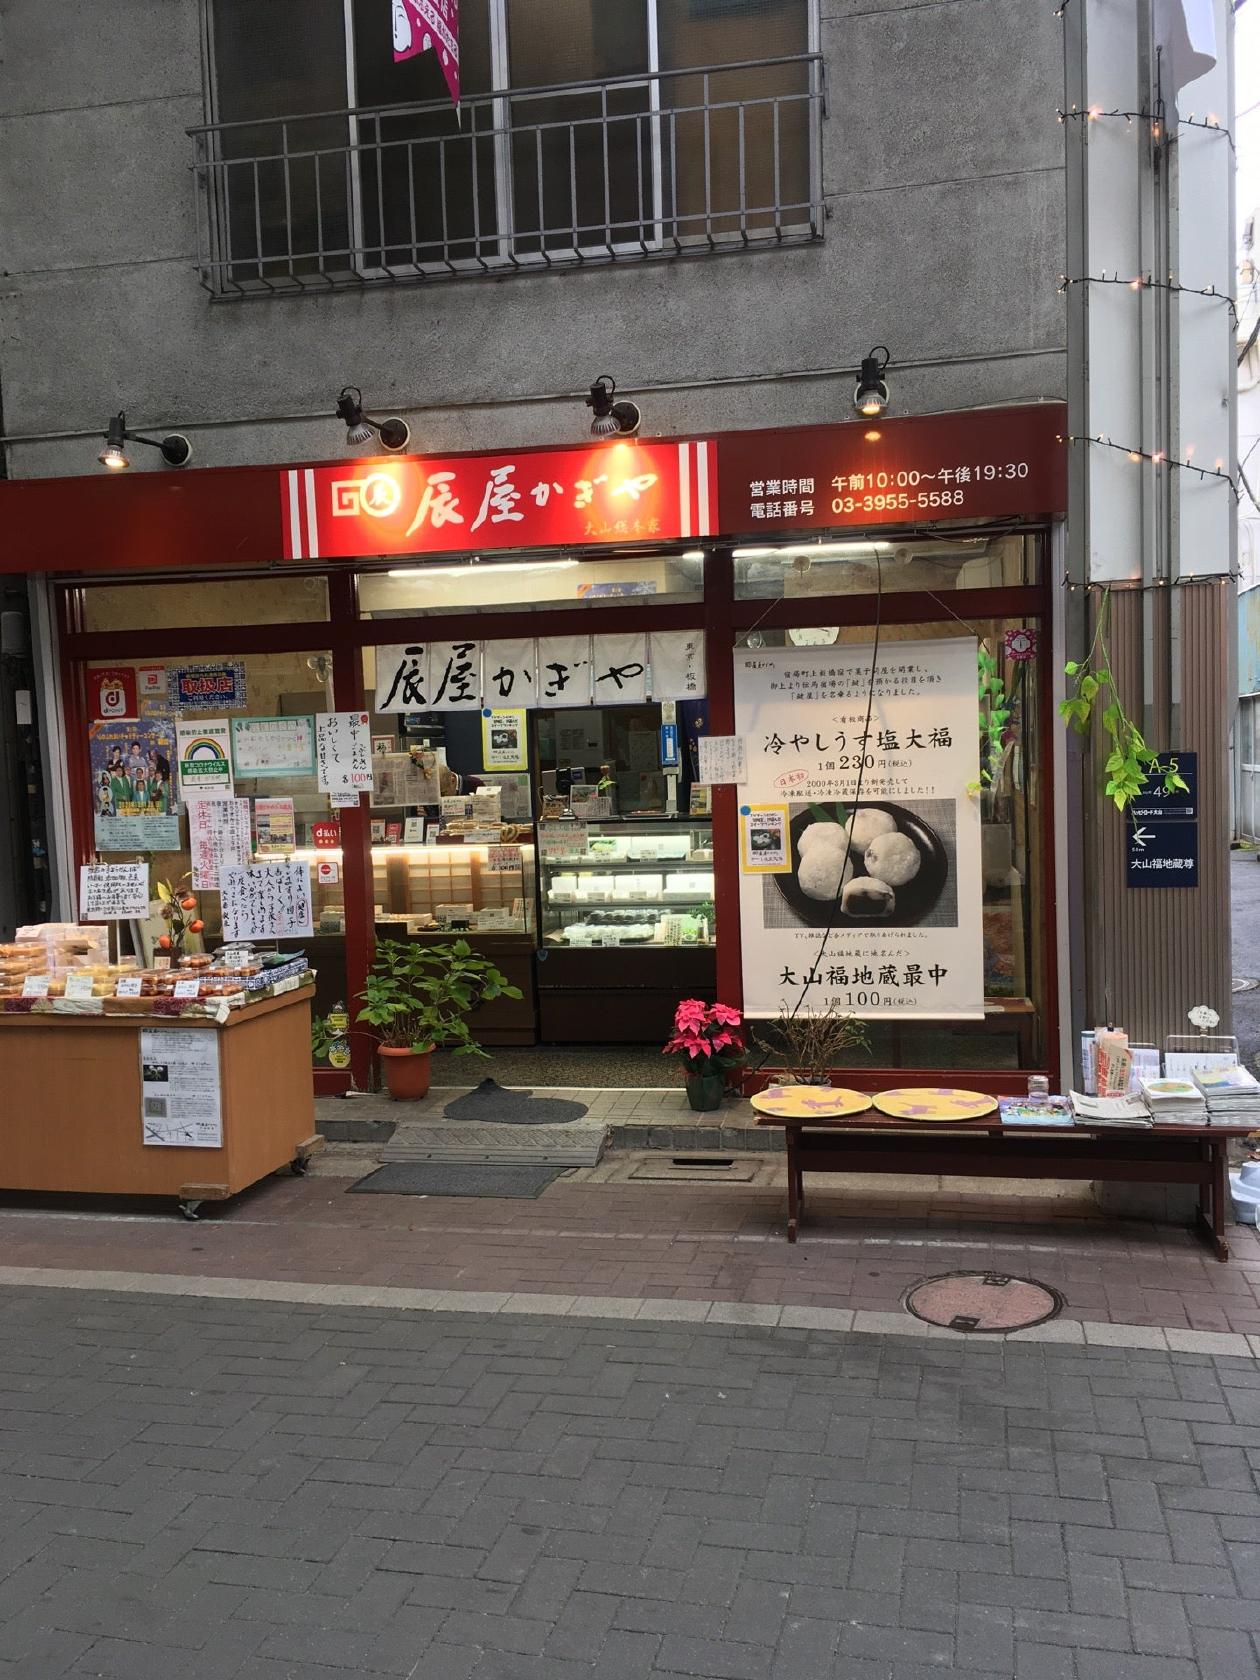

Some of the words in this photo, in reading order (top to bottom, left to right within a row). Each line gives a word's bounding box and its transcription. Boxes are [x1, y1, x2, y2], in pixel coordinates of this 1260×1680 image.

[405, 464, 659, 537] 辰屋かぎや
[750, 477, 815, 498] 営業時間
[750, 499, 815, 519] 電話番号
[831, 489, 965, 514] 03-3955-5588
[181, 677, 234, 694] 取扱店
[380, 642, 644, 710] 辰屋かぎや
[327, 716, 341, 764] おいしくて
[763, 727, 953, 756] 冷やしうす塩大福
[197, 800, 208, 829] 定休日
[1130, 858, 1194, 870] 大山福地蔵尊
[778, 963, 949, 988] 大山福地蔵最中
